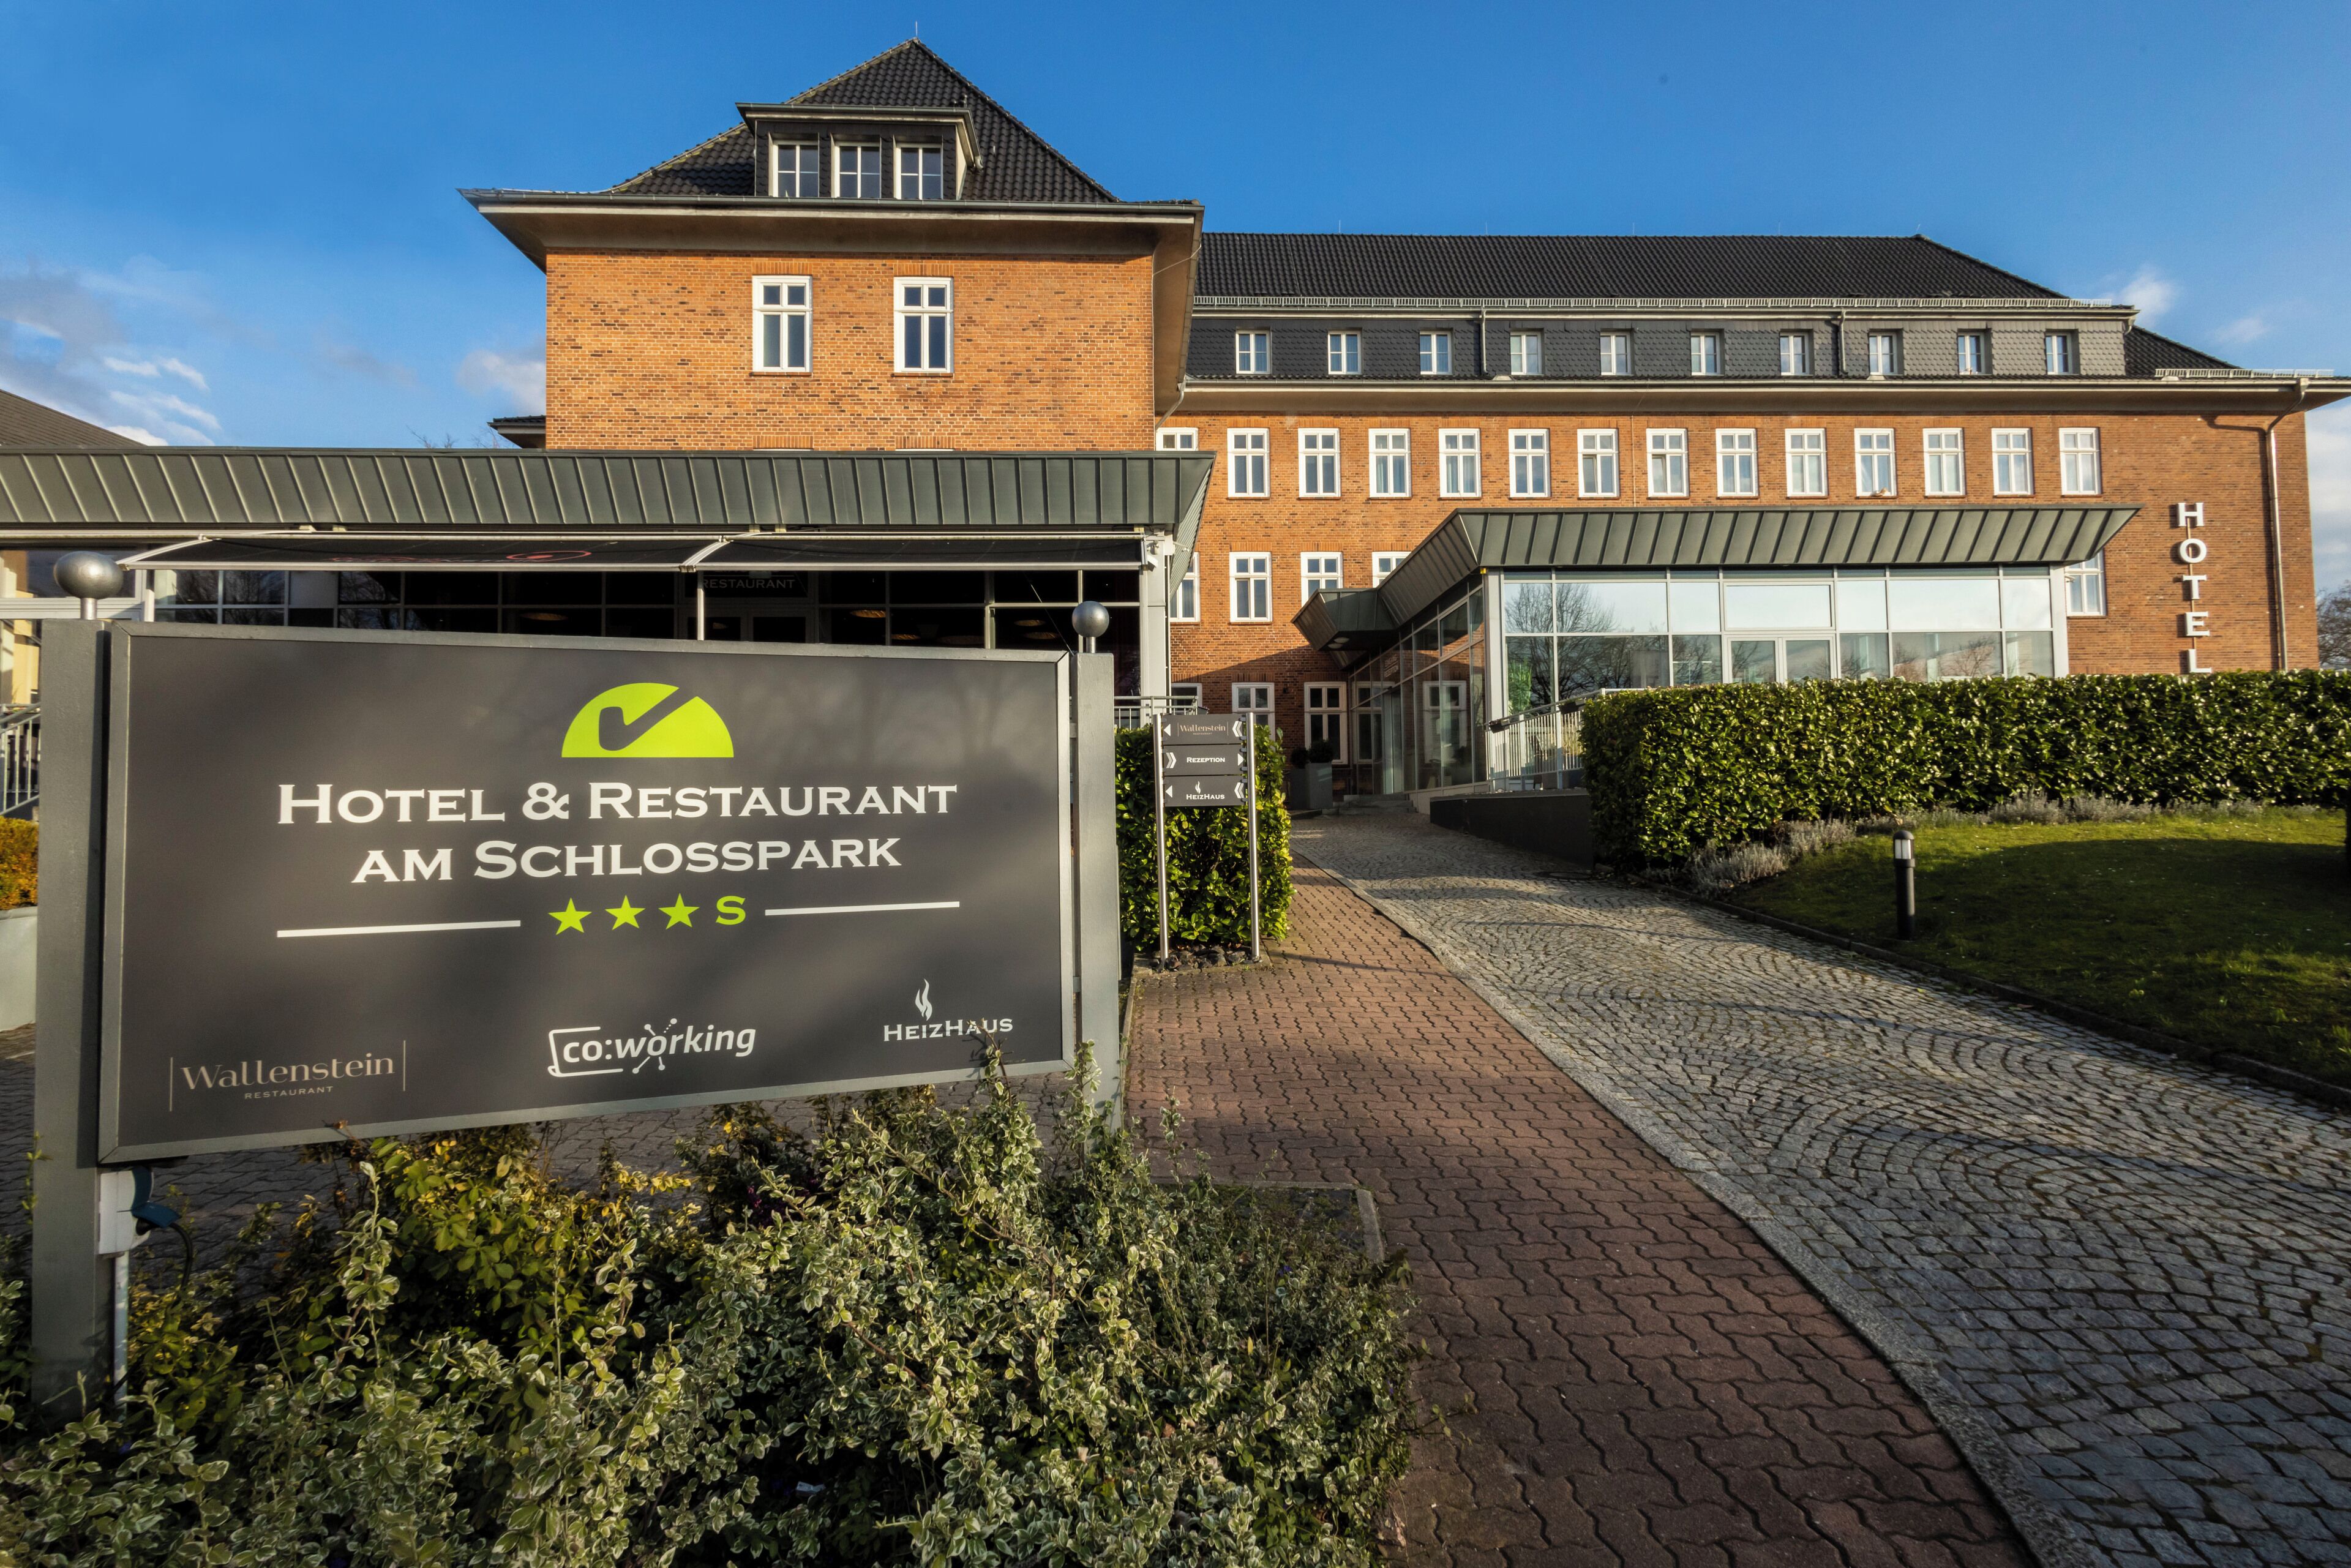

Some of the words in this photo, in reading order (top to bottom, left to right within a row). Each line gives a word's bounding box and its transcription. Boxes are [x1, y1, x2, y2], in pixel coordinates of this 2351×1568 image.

[2177, 502, 2212, 673] HOTEL
[277, 784, 506, 824] HOTEL
[522, 781, 570, 820] &
[588, 781, 958, 820] RESTAURANT
[350, 848, 454, 883] AM
[474, 838, 902, 879] SCHLOSSPARK
[715, 895, 746, 926] S
[563, 1024, 756, 1063] co:working
[180, 1052, 396, 1090] Wallenstein
[244, 1085, 334, 1100] RESTAURANT
